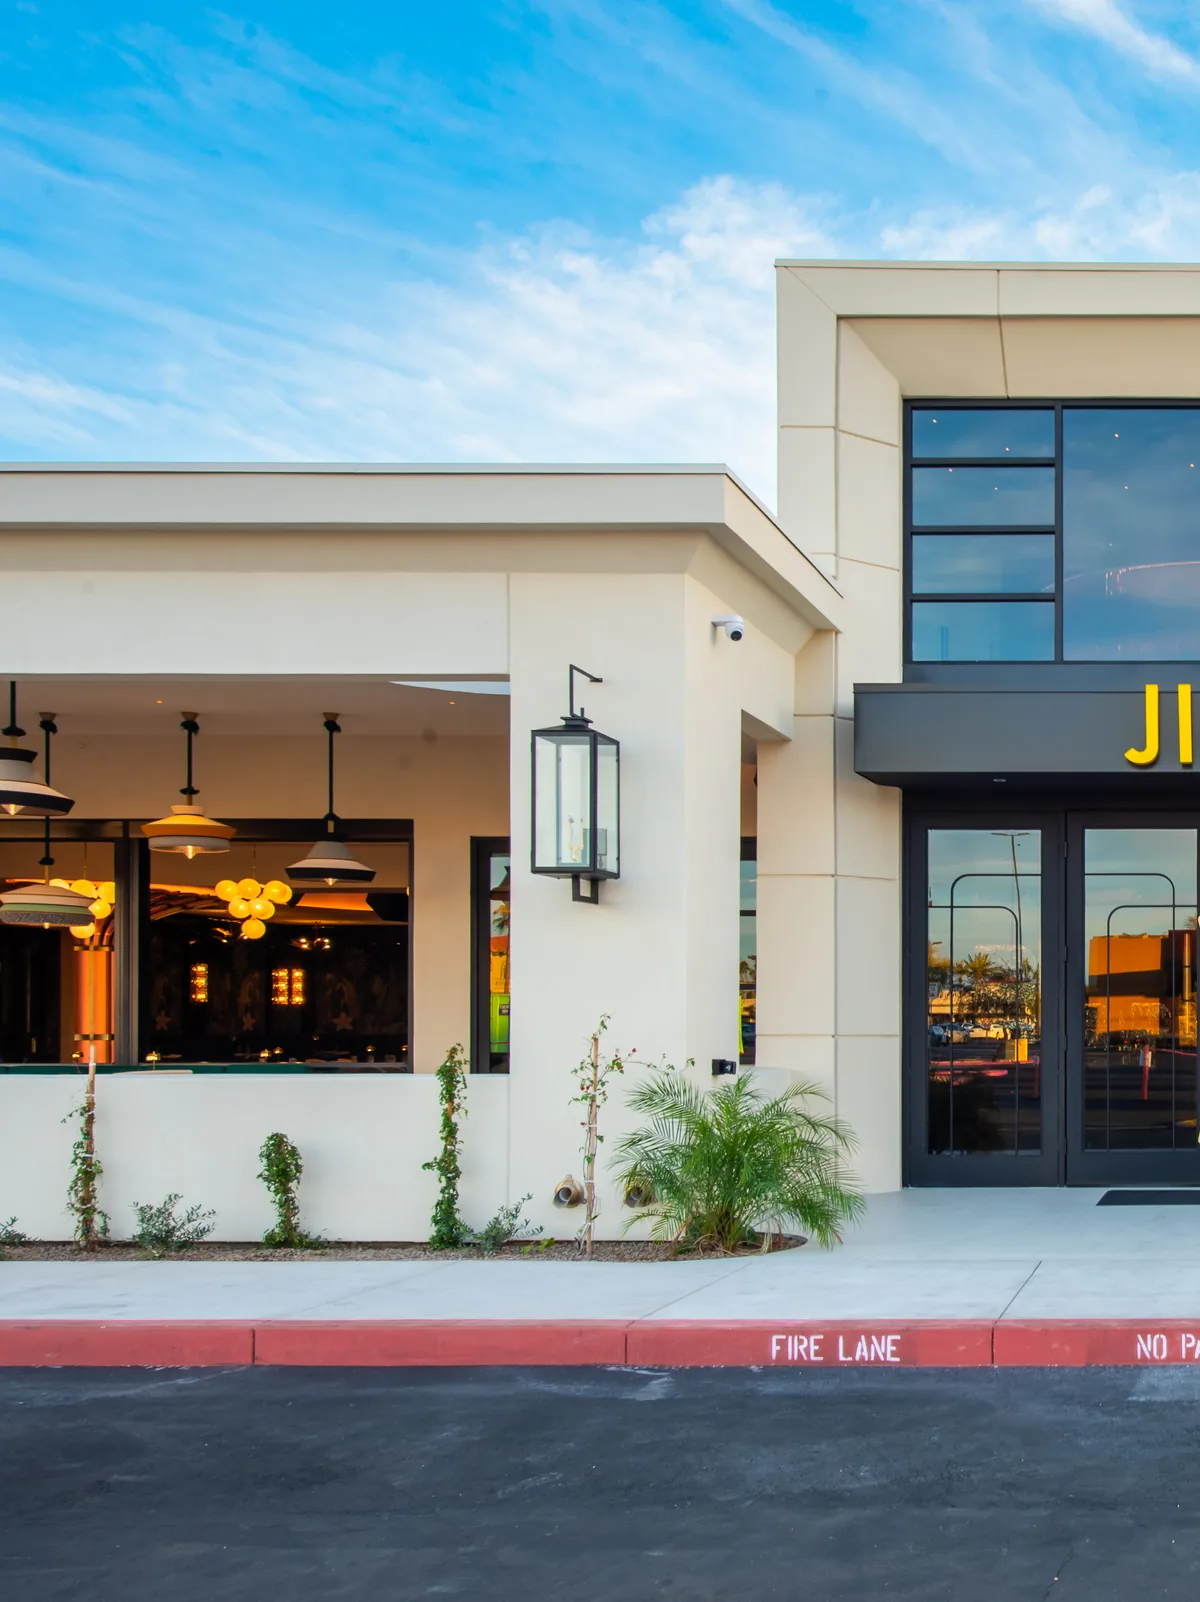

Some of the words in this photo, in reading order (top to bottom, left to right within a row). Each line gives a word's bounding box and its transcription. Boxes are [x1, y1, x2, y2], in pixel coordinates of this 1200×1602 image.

[771, 1334, 824, 1361] FIRE
[838, 1334, 901, 1362] LANE
[1136, 1333, 1168, 1360] NO
